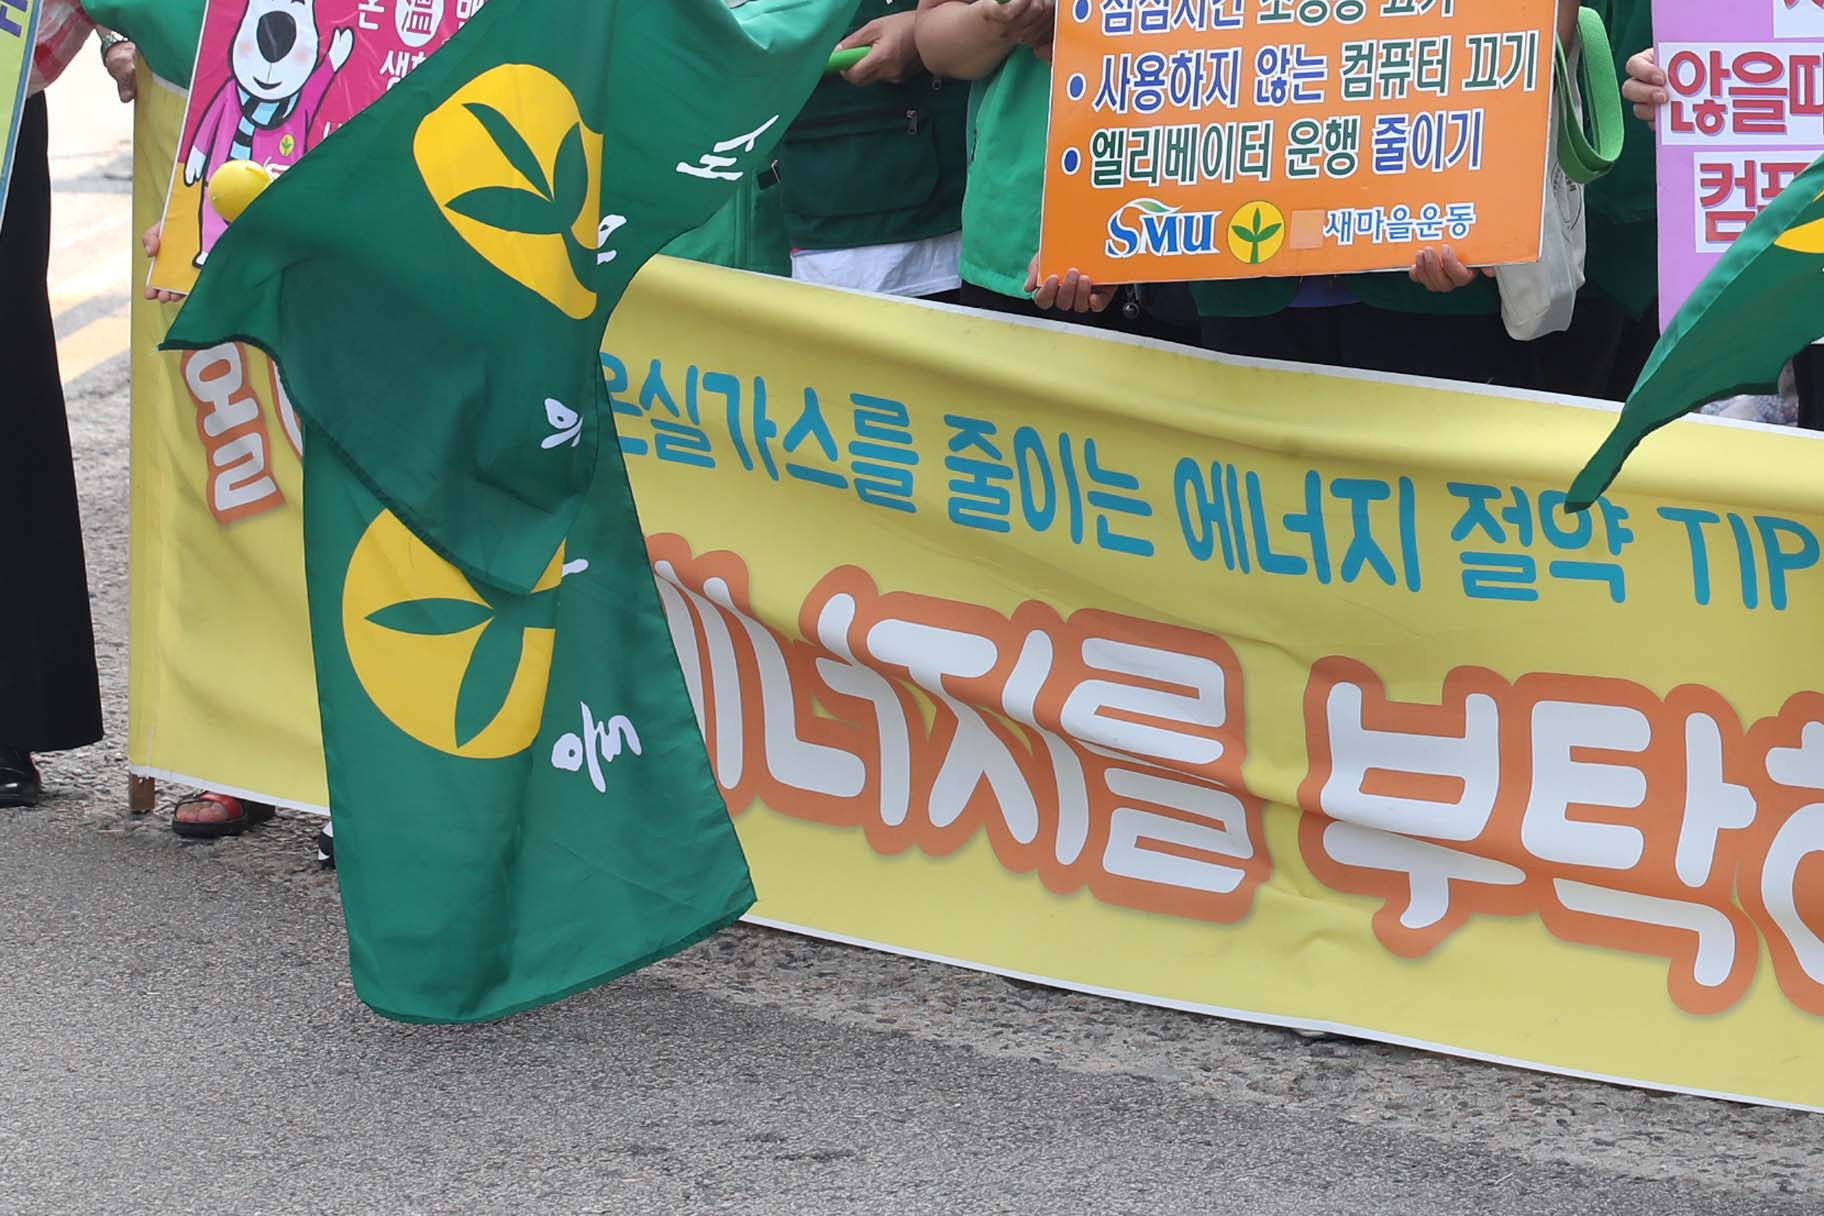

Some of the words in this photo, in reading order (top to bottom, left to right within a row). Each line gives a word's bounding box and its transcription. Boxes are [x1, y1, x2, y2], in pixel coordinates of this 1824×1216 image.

[1092, 49, 1241, 115] 사용하지
[1254, 44, 1327, 106] 않는
[1340, 32, 1450, 100] 컴퓨터
[1461, 30, 1540, 92] 끄기
[1089, 119, 1272, 190] 엘리베이터
[1285, 117, 1360, 180] 운행
[1372, 108, 1486, 175] 줄이기
[1105, 197, 1223, 259] SMU
[1322, 201, 1476, 247] 새마을운동
[943, 412, 1154, 558] 줄이는
[1174, 457, 1421, 593] 에너지
[1446, 480, 1634, 604] 절약
[1656, 506, 1822, 612] TIP
